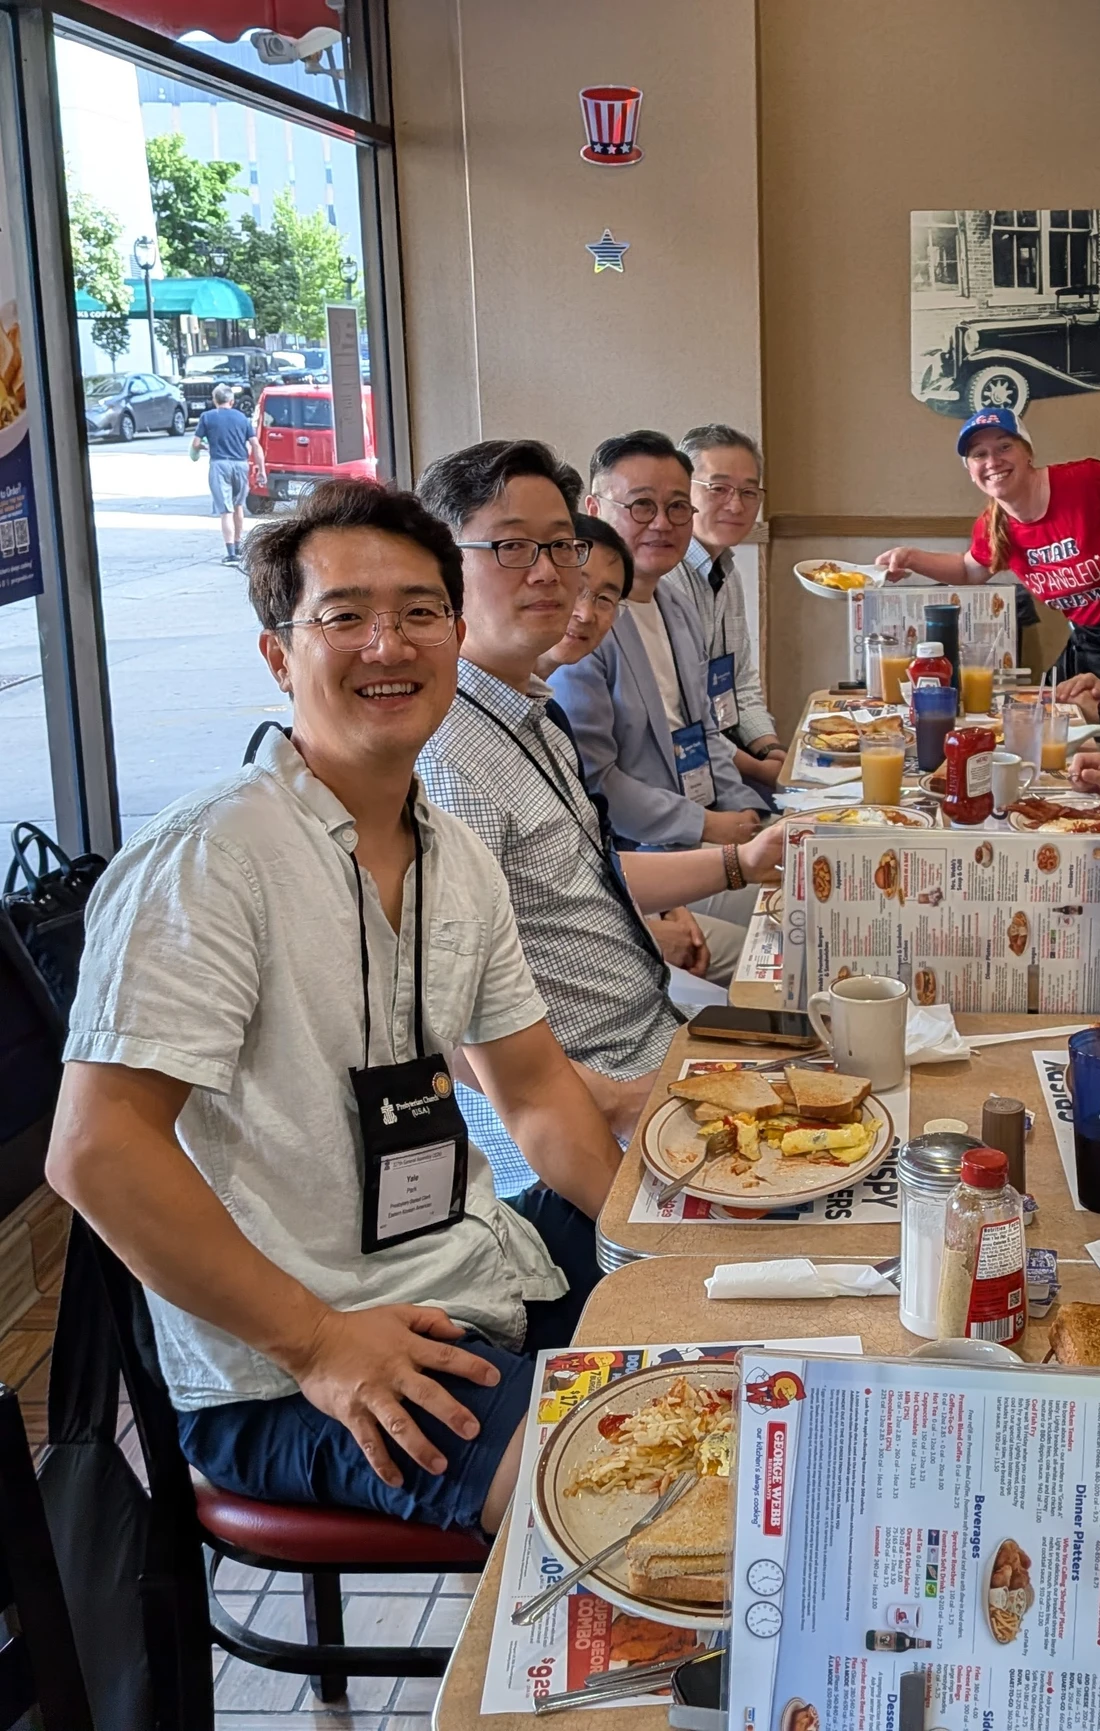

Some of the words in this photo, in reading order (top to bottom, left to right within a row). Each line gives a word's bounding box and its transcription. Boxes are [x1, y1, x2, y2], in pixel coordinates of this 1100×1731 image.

[1027, 537, 1080, 566] STAR
[406, 1174, 419, 1183] Yale
[824, 1184, 852, 1220] ERS
[1028, 1426, 1036, 1436] Fry
[754, 1441, 762, 1472] kitchen's
[771, 1429, 785, 1485] GEORGE
[751, 1474, 761, 1495] always
[765, 1456, 773, 1500] RESTAURANTS
[769, 1485, 783, 1527] WEBB
[969, 1495, 984, 1558] Beverages
[1074, 1484, 1086, 1527] Dinner
[1071, 1531, 1084, 1580] Platters
[575, 1598, 594, 1650] COMBO
